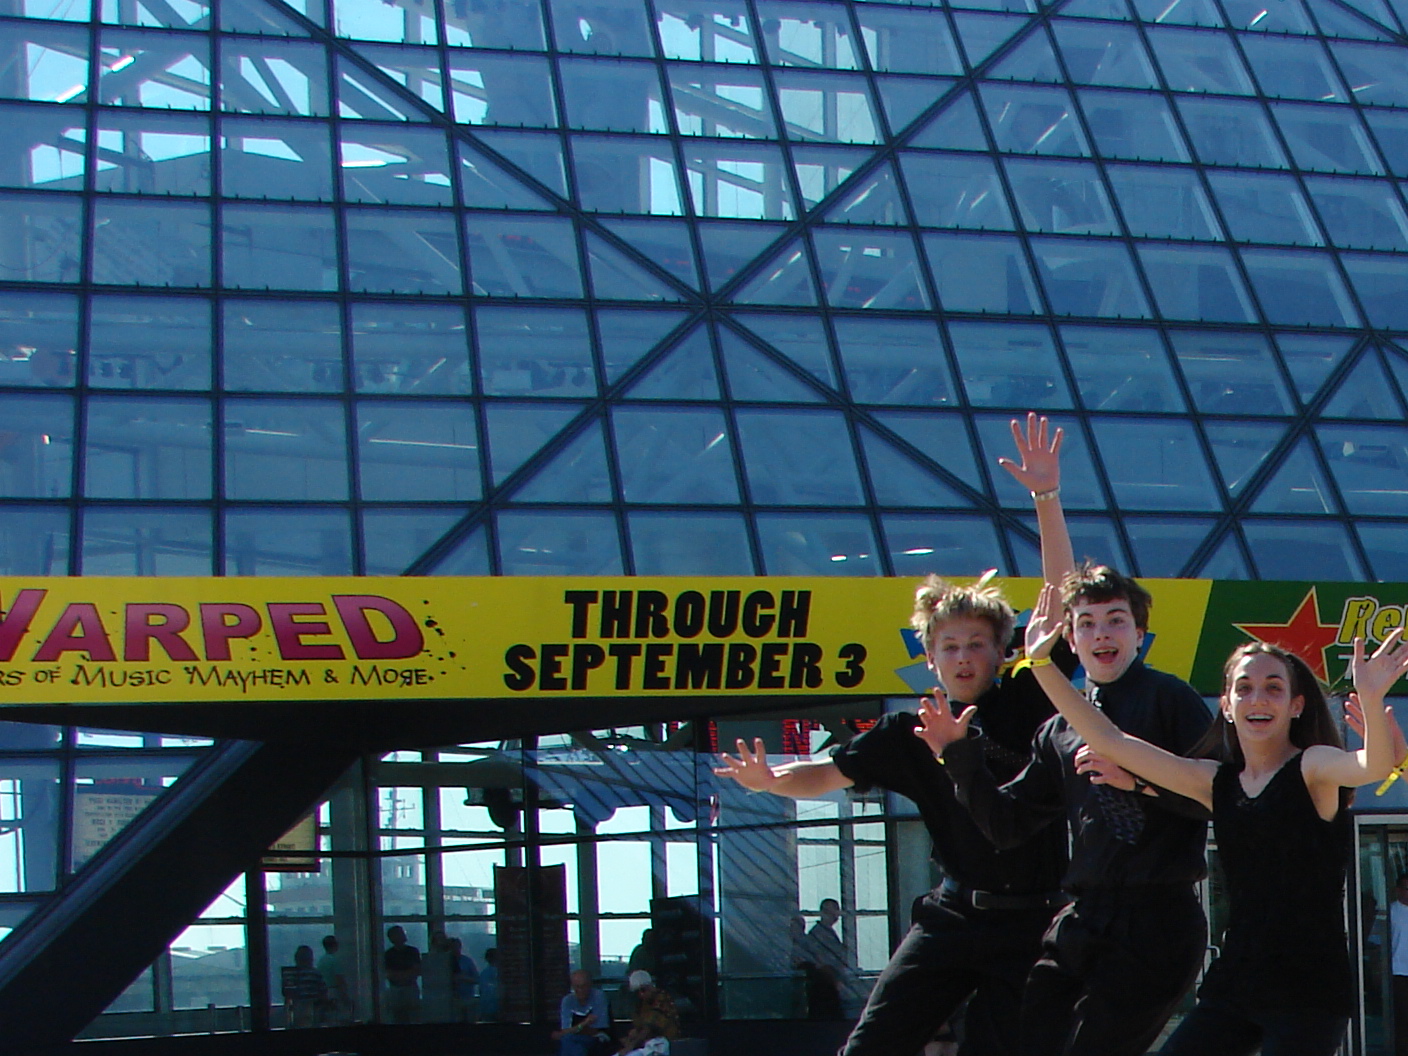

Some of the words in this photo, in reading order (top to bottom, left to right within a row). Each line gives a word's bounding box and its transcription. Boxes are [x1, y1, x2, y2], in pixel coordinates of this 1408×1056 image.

[563, 589, 813, 639] THROUGH
[34, 665, 62, 684] OF
[71, 664, 172, 688] MUSIC
[184, 665, 311, 693] MAYHEM
[324, 668, 338, 684] &
[502, 642, 823, 692] SEPTEMBER
[834, 642, 868, 689] 3
